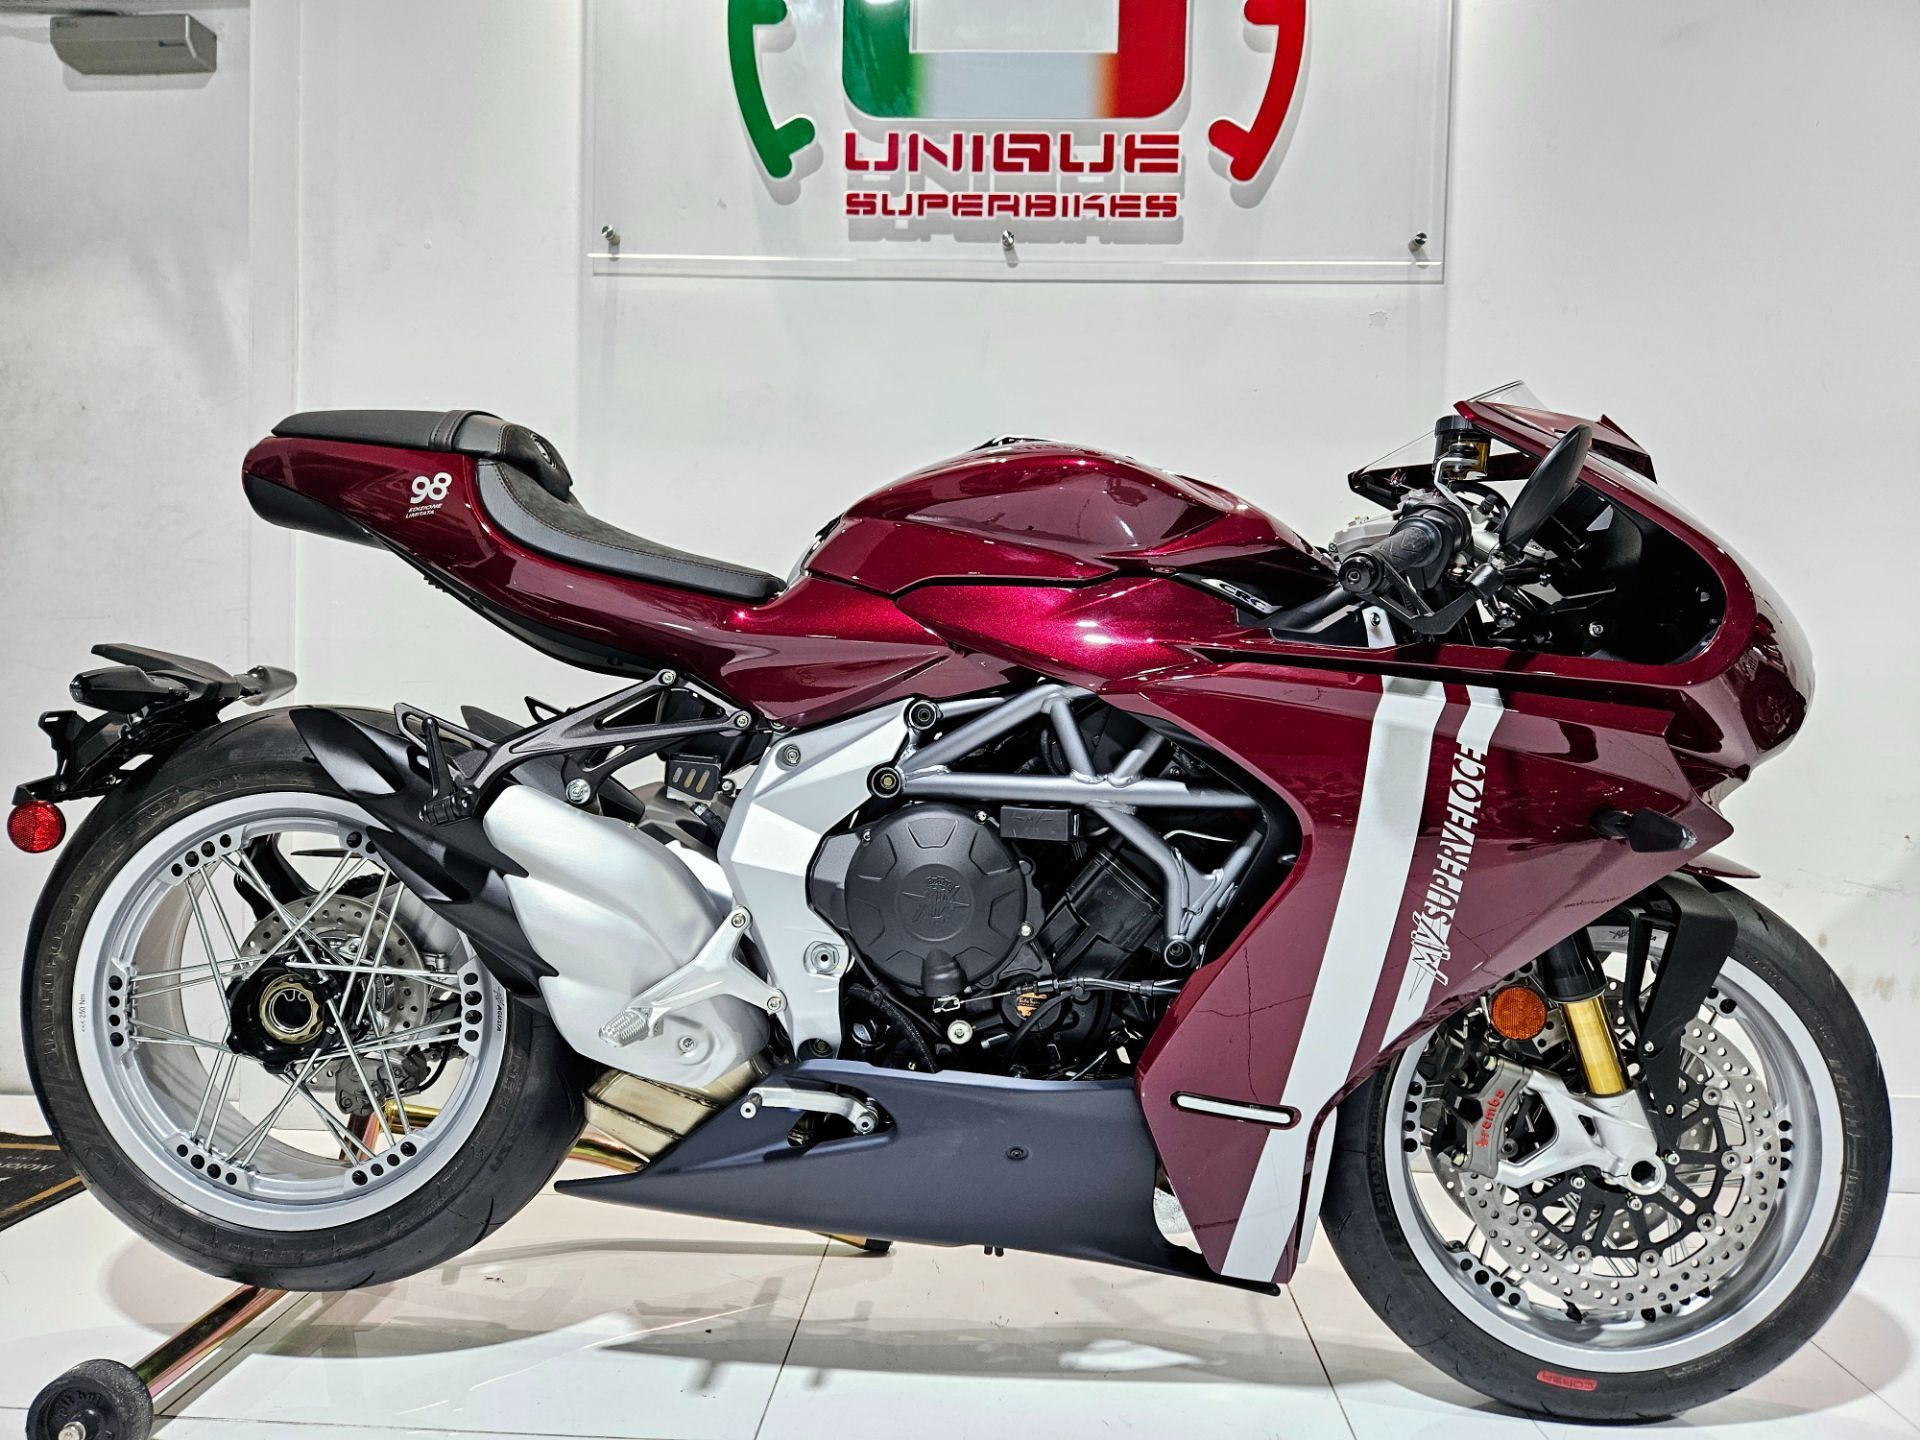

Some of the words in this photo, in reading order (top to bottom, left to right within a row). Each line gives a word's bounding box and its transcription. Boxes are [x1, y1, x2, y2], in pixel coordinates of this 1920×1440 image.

[845, 132, 1180, 173] UNIQUE
[846, 193, 1178, 218] SUPERBIKES
[410, 472, 452, 504] 98
[1422, 739, 1489, 927] SUPERVELOCE
[1475, 1089, 1505, 1147] brembo
